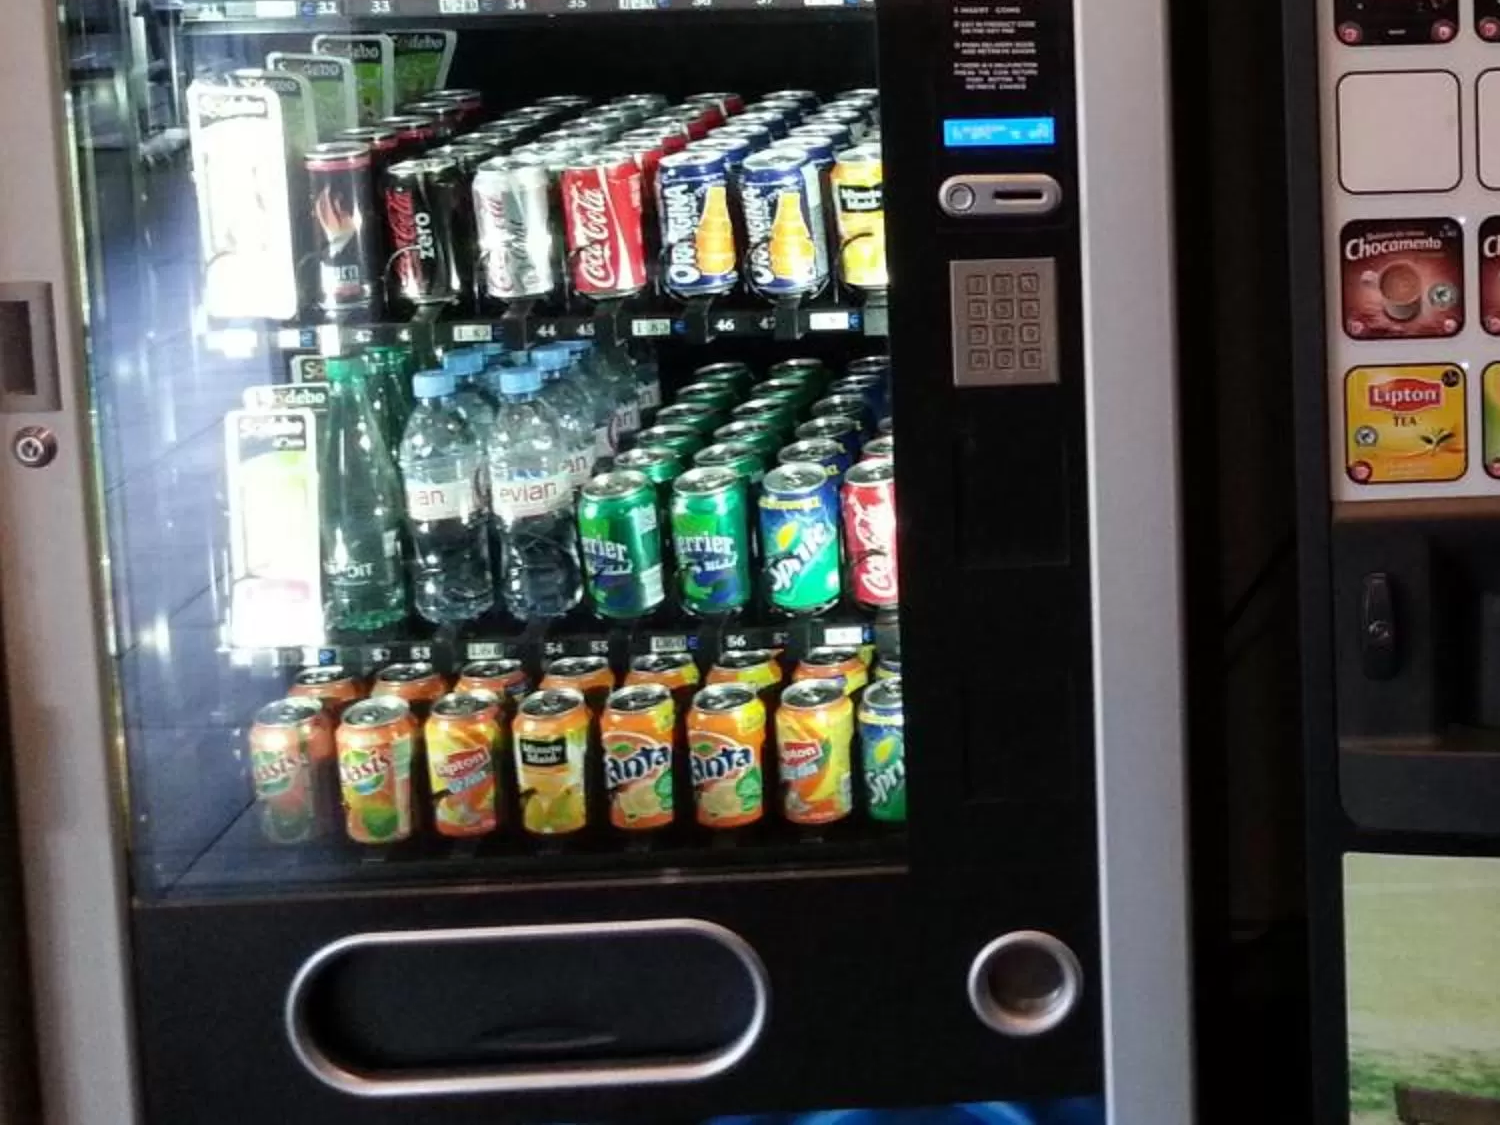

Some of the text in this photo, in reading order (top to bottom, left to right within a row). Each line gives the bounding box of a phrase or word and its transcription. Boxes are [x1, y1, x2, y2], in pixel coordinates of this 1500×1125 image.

[370, 0, 391, 13] 33
[415, 211, 435, 260] zero
[570, 180, 616, 288] Coca-Cola
[1345, 236, 1442, 261] Chocamento
[535, 324, 557, 337] 44
[715, 318, 735, 332] 46
[1372, 387, 1437, 405] Lipton
[1392, 415, 1417, 427] TEA
[499, 480, 558, 503] evian
[675, 534, 735, 556] errier
[725, 635, 746, 648] 56
[604, 745, 670, 789] anta
[690, 746, 753, 786] anta
